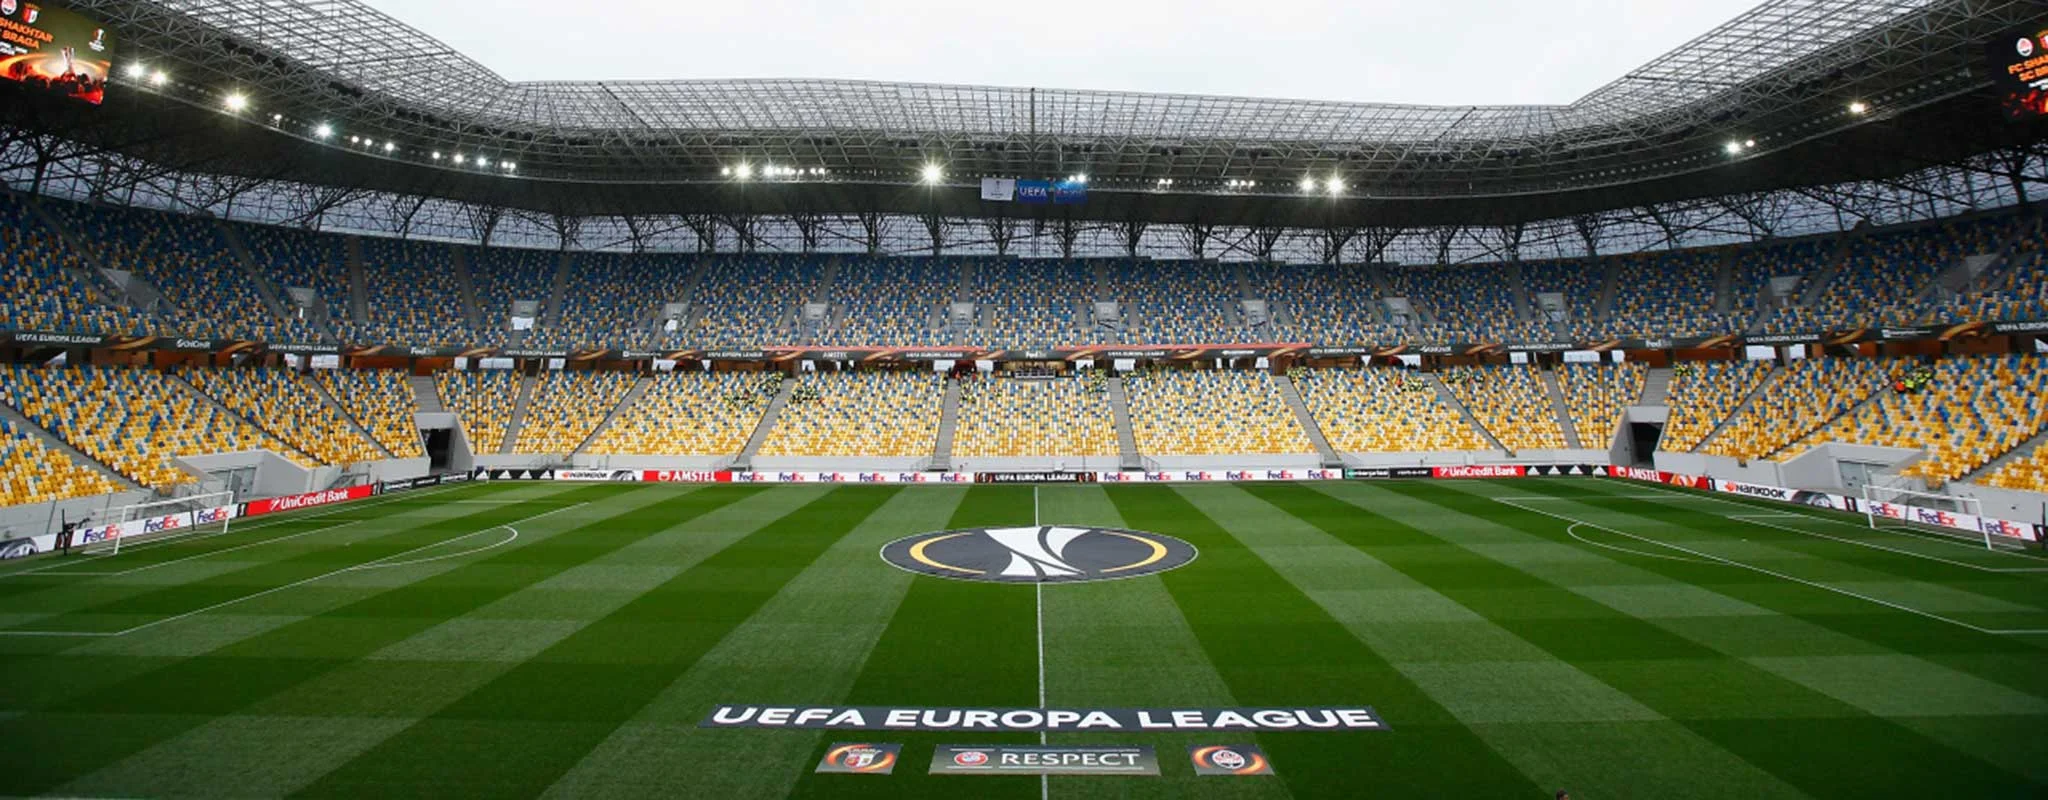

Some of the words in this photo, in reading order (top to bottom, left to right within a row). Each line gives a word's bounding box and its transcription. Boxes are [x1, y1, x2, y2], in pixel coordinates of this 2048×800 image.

[2, 30, 39, 49] BRAGA
[1020, 187, 1047, 197] UEFA
[671, 471, 717, 481] AMSTEL
[738, 471, 765, 482] FedEx
[778, 471, 805, 482] FedEx
[818, 471, 845, 482] FedEx
[859, 472, 885, 482] FedEx
[899, 472, 926, 482] FedEx
[940, 472, 966, 482] FedEx
[995, 473, 1015, 481] UEFA
[1016, 473, 1046, 481] EUROPA
[1047, 473, 1076, 481] LEAGUE
[1104, 471, 1130, 481] FedEx
[1144, 471, 1171, 481] FedEx
[1185, 471, 1212, 481] FedEx
[1226, 470, 1253, 480] FedEx
[1267, 470, 1294, 480] FedEx
[1308, 469, 1334, 480] FedEx
[1450, 466, 1493, 477] UniCredit
[1627, 468, 1662, 483] AMSTEL
[281, 491, 326, 510] UniCredit
[327, 488, 349, 502] Bank
[197, 506, 229, 524] FedEx
[1869, 501, 1899, 518] edEx
[1917, 508, 1957, 527] FedEx
[143, 515, 180, 533] FedEx
[83, 523, 122, 543] FedEx
[712, 707, 866, 727] UEFA
[884, 709, 1121, 728] EUROPA
[1136, 708, 1380, 728] LEAGUE
[1000, 753, 1139, 766] RESPECT
